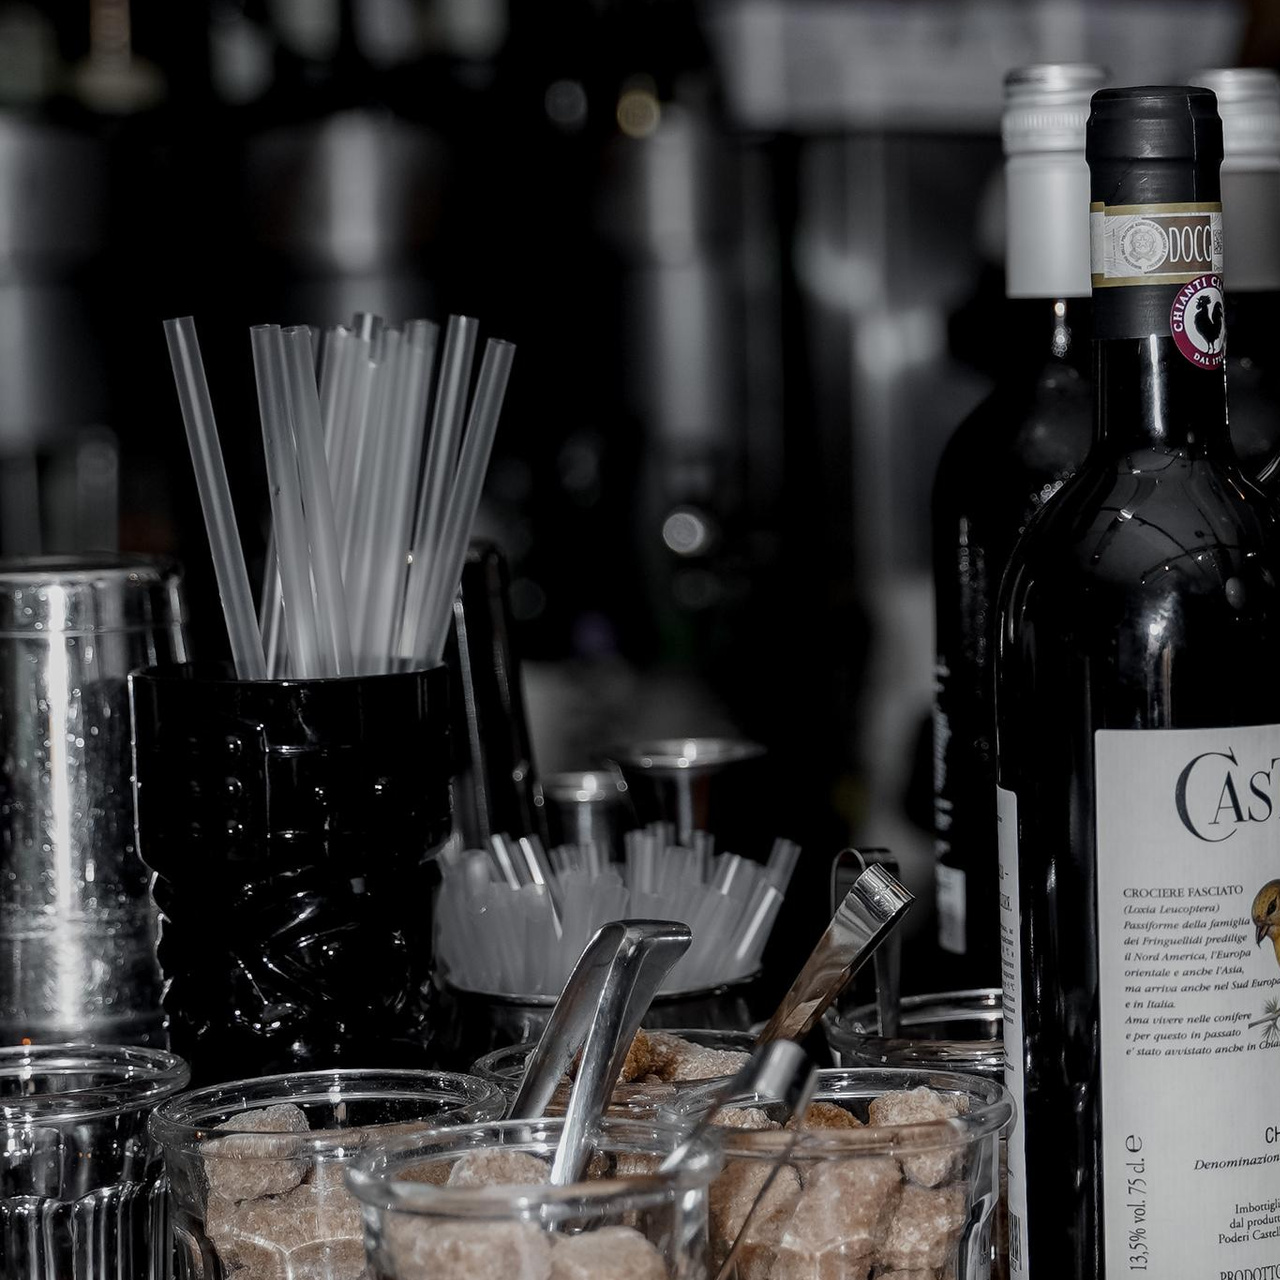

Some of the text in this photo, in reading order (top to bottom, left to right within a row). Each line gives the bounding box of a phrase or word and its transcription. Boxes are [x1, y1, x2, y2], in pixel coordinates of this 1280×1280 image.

[1169, 225, 1212, 262] DOCG
[1173, 276, 1207, 332] CHIANTI
[1123, 885, 1244, 898] CROCIERE FASCIATO
[1123, 903, 1220, 915] (Loxia Leucoptera)
[1123, 918, 1251, 931] Passiforme della famiglia
[1124, 933, 1248, 948] dei Fringuellidi predilige
[1124, 949, 1251, 963] il Nord America, l'Europa
[1125, 967, 1171, 977] orientale
[1182, 966, 1213, 976] anche
[1215, 965, 1245, 975] l'Asia,
[1125, 985, 1141, 993] ma
[1144, 983, 1179, 992] arriva
[1181, 981, 1212, 992] anche
[1214, 980, 1229, 990] nel
[1231, 979, 1249, 990] Sud
[1133, 1000, 1144, 1009] in
[1147, 999, 1176, 1009] Italia.
[1125, 1011, 1252, 1025] Ama vivere nelle conifere
[1133, 1032, 1150, 1043] per
[1153, 1031, 1187, 1042] questo
[1190, 1030, 1201, 1040] in
[1204, 1028, 1241, 1041] passato
[1136, 1047, 1162, 1056] stato
[1164, 1045, 1212, 1056] avvistato
[1215, 1043, 1244, 1054] anche
[1246, 1042, 1257, 1051] in
[1126, 1158, 1145, 1174] cl.
[1127, 1178, 1147, 1195] 75
[1126, 1200, 1146, 1224] vol.
[1230, 1217, 1244, 1229] dal
[1218, 1231, 1250, 1244] Poderi
[1128, 1228, 1149, 1270] 13,5%
